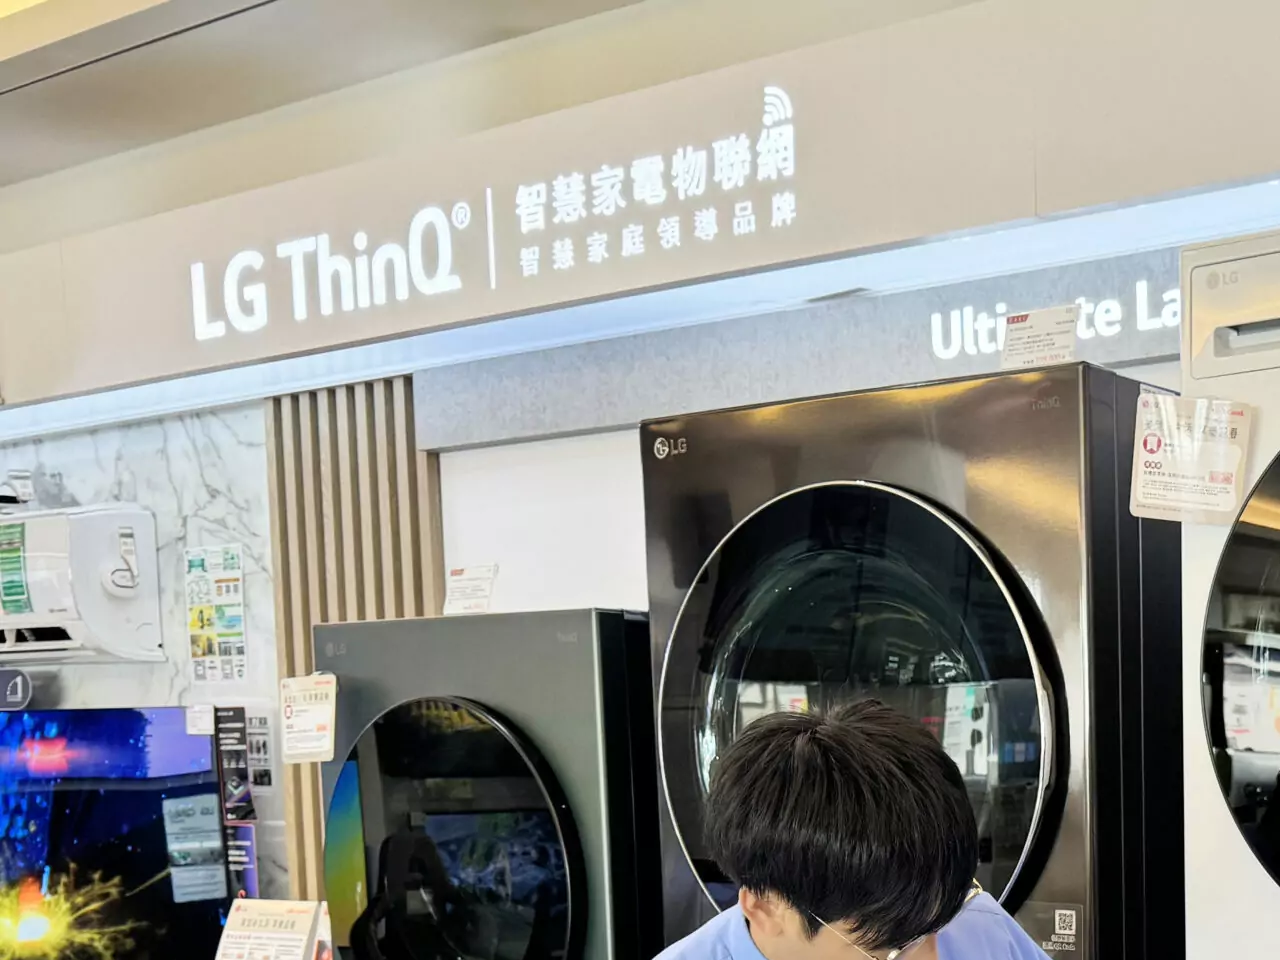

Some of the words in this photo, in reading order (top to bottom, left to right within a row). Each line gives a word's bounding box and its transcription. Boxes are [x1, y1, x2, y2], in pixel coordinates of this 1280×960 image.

[515, 124, 795, 234] 智慧家電物聯網
[519, 191, 797, 277] 智慧家庭領導品牌
[190, 250, 268, 341] LG
[1222, 271, 1239, 286] LG
[930, 296, 1123, 360] Ultite
[669, 438, 688, 456] LG
